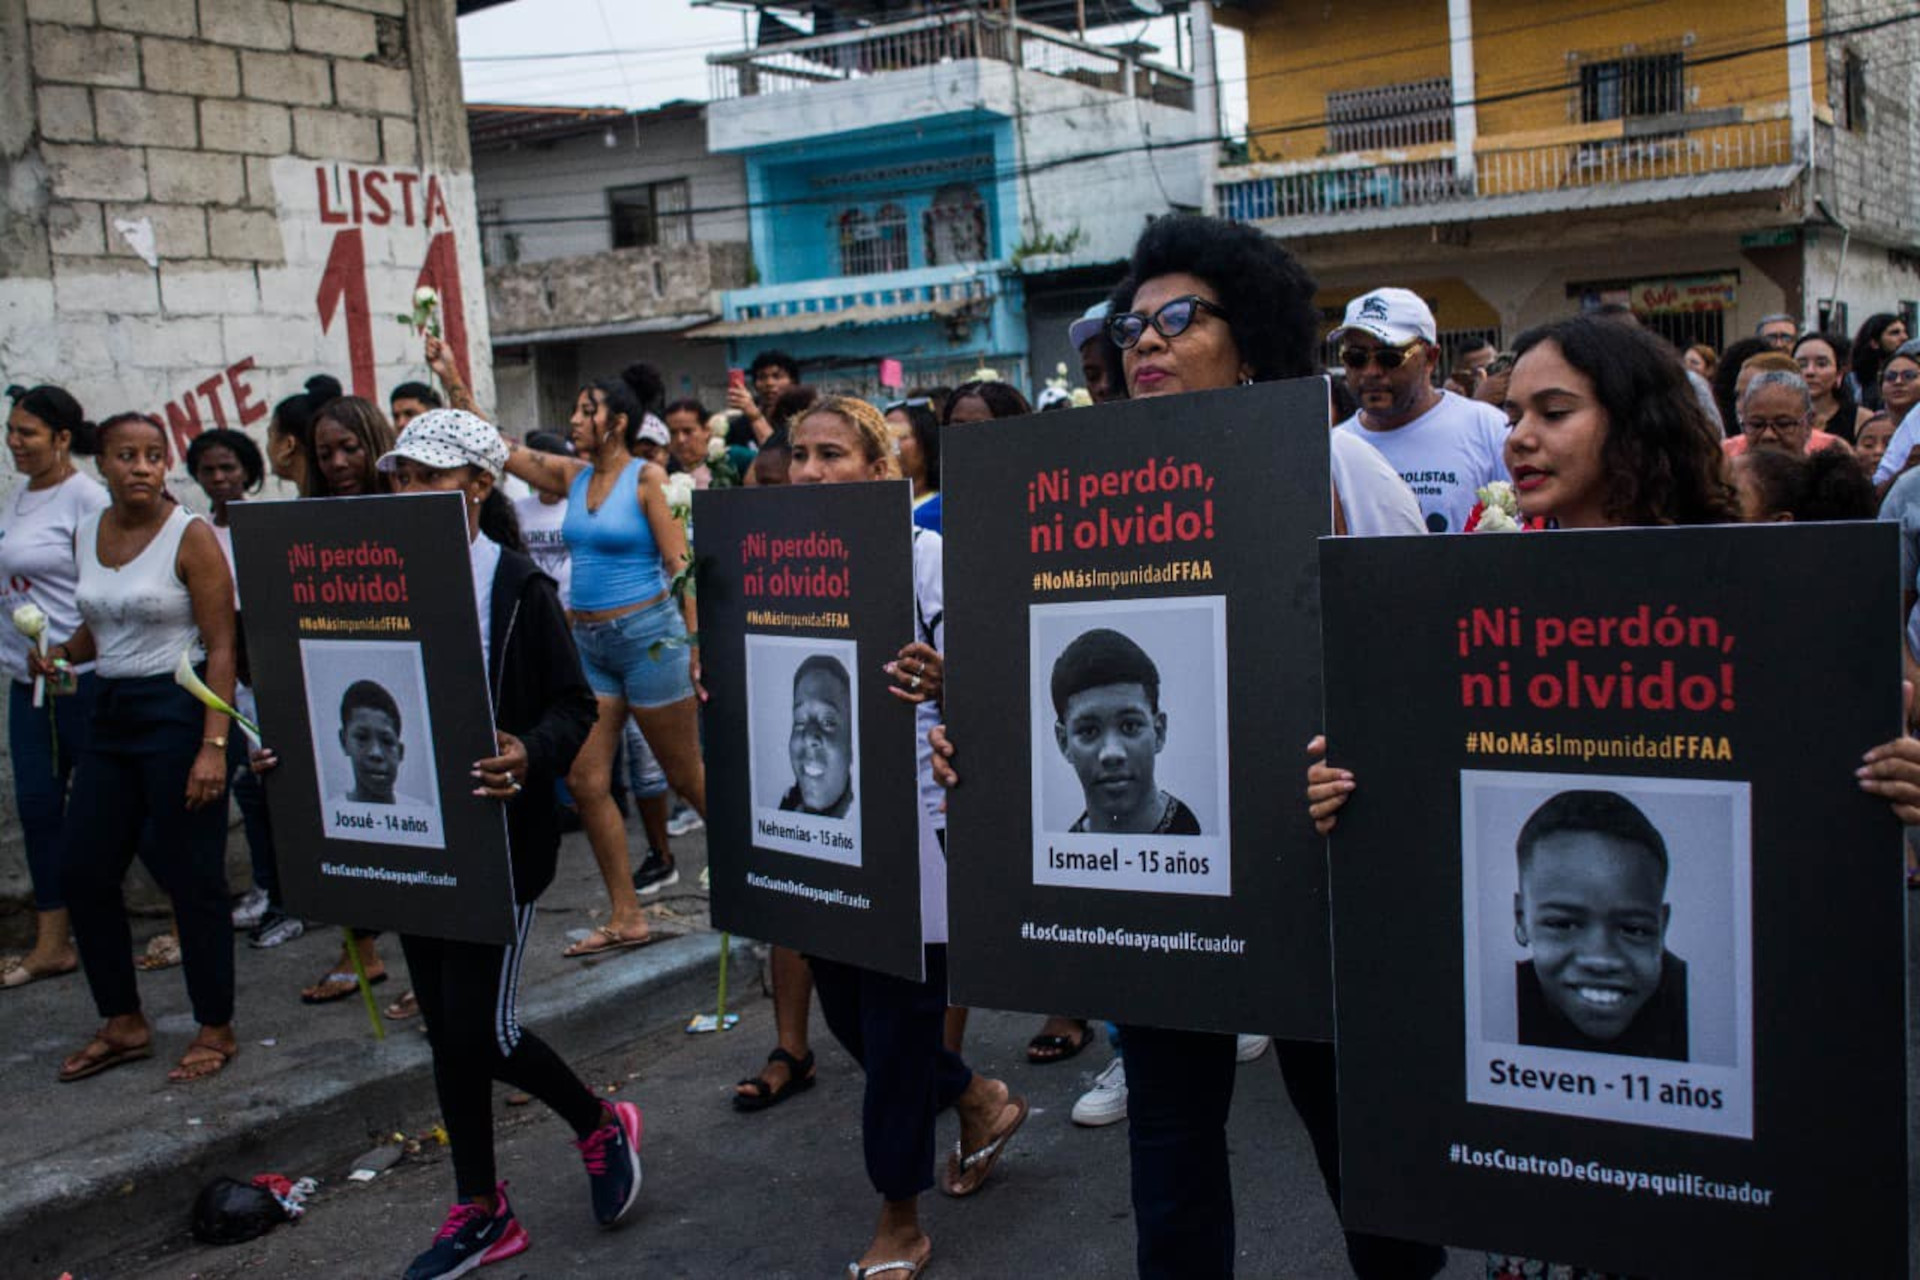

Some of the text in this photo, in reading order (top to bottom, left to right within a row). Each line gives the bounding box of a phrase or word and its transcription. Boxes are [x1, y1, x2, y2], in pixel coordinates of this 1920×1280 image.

[315, 166, 452, 229] LISTA
[316, 227, 476, 406] 11
[150, 355, 268, 472] NTE
[1028, 456, 1215, 514] ¡Ni perdón,
[1030, 499, 1215, 553] ni olvido!
[287, 540, 405, 575] ¡Ni perdón,
[742, 530, 850, 565] ¡Ni perdón,
[293, 573, 409, 603] ni olvido!
[743, 563, 851, 599] ni olvido!
[1032, 560, 1214, 592] #NoMásImpunidadFFAA
[1457, 604, 1736, 658] ¡Ni perdón,
[1461, 659, 1737, 712] ni olvido!
[1466, 731, 1733, 762] #NoMásImpunidadFFAA
[335, 810, 374, 829] Josué
[385, 814, 400, 831] 14
[401, 816, 429, 834] años
[820, 829, 831, 846] 15
[832, 832, 854, 850] años
[1049, 847, 1118, 872] Ismael
[1138, 850, 1159, 873] 15
[1165, 852, 1210, 875] años
[1021, 922, 1247, 955] #LosCuatroDeGuayaquilEcuador
[1489, 1060, 1597, 1096] Steven
[1622, 1073, 1650, 1102] 11
[1659, 1079, 1723, 1110] años
[1449, 1143, 1773, 1206] #LosCuatroDeGuayaquilEcuador
